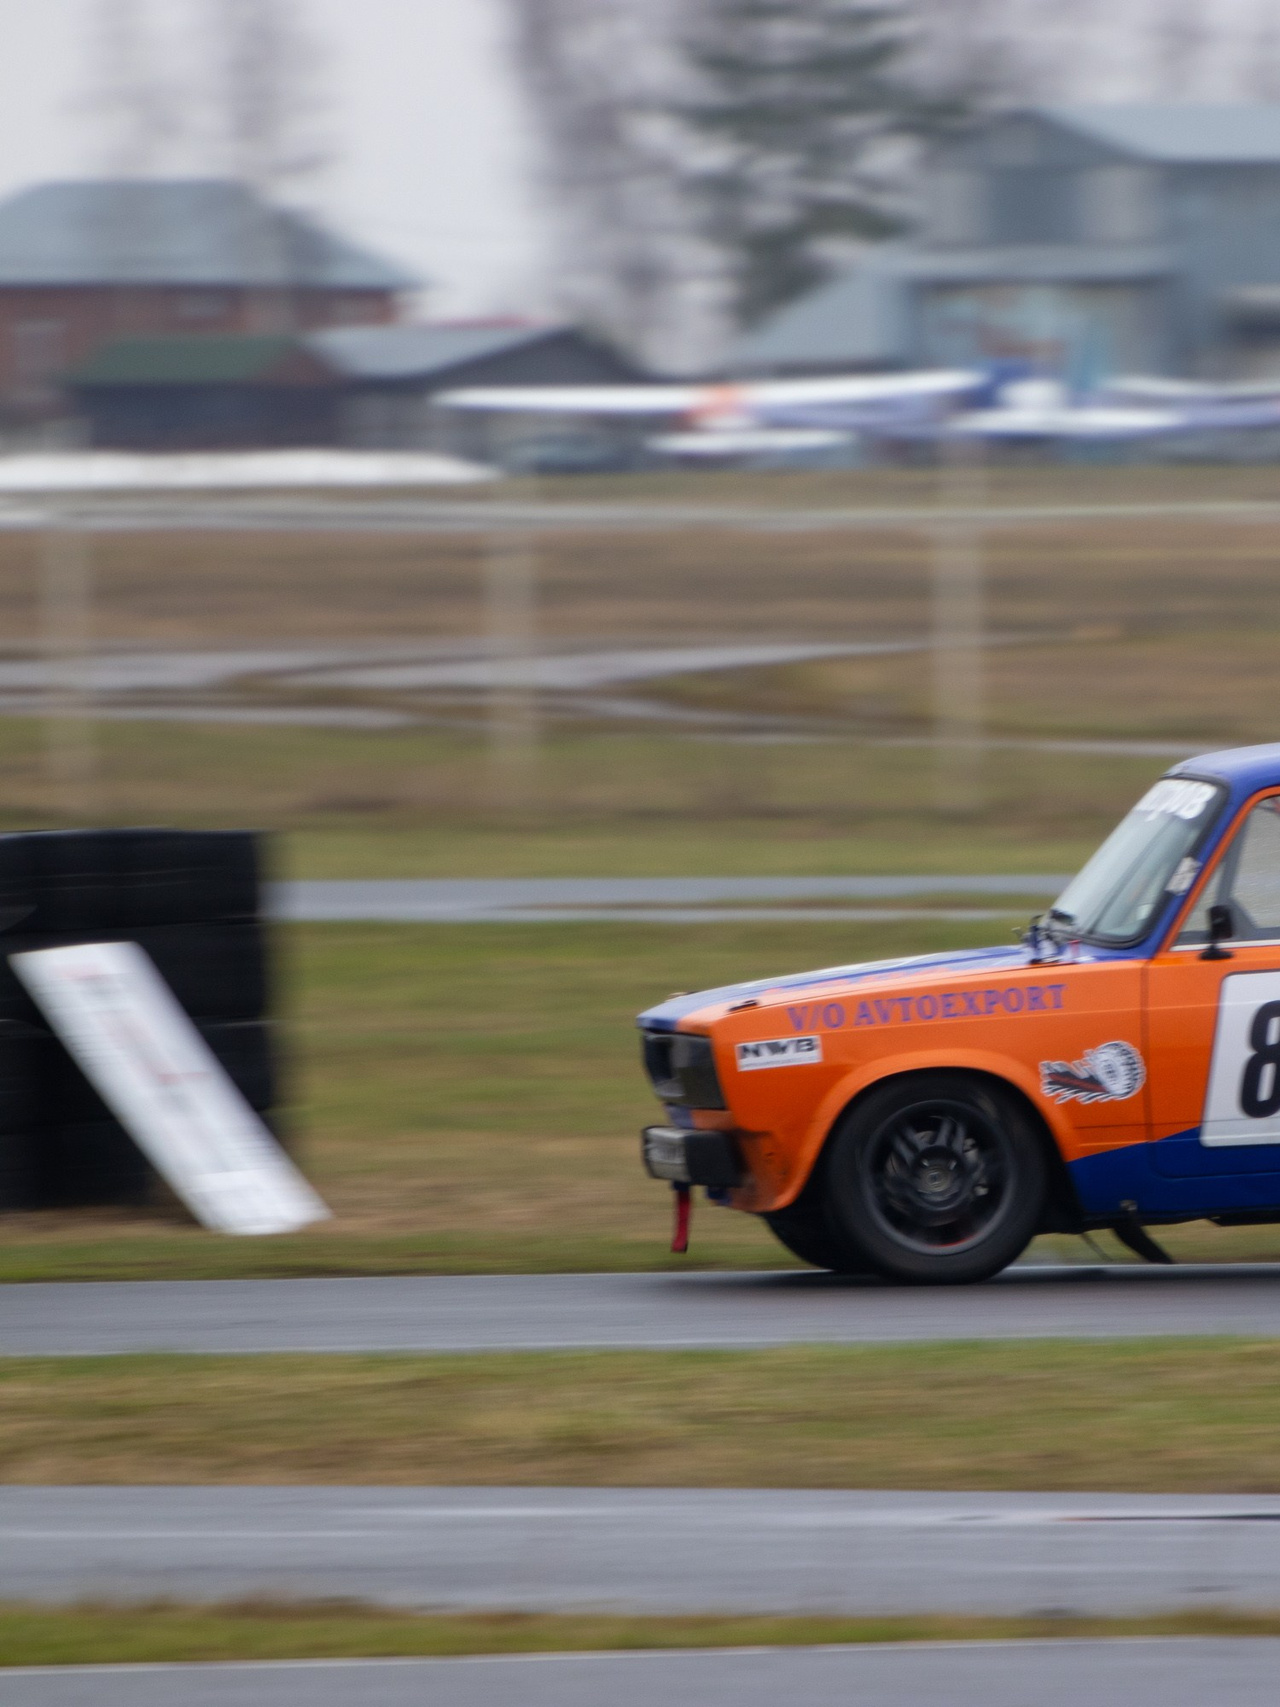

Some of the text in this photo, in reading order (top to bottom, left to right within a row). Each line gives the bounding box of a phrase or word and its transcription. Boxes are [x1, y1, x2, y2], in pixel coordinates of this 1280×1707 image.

[786, 983, 1068, 1032] V/O AVTOEXPORT
[737, 1038, 816, 1060] NWB
